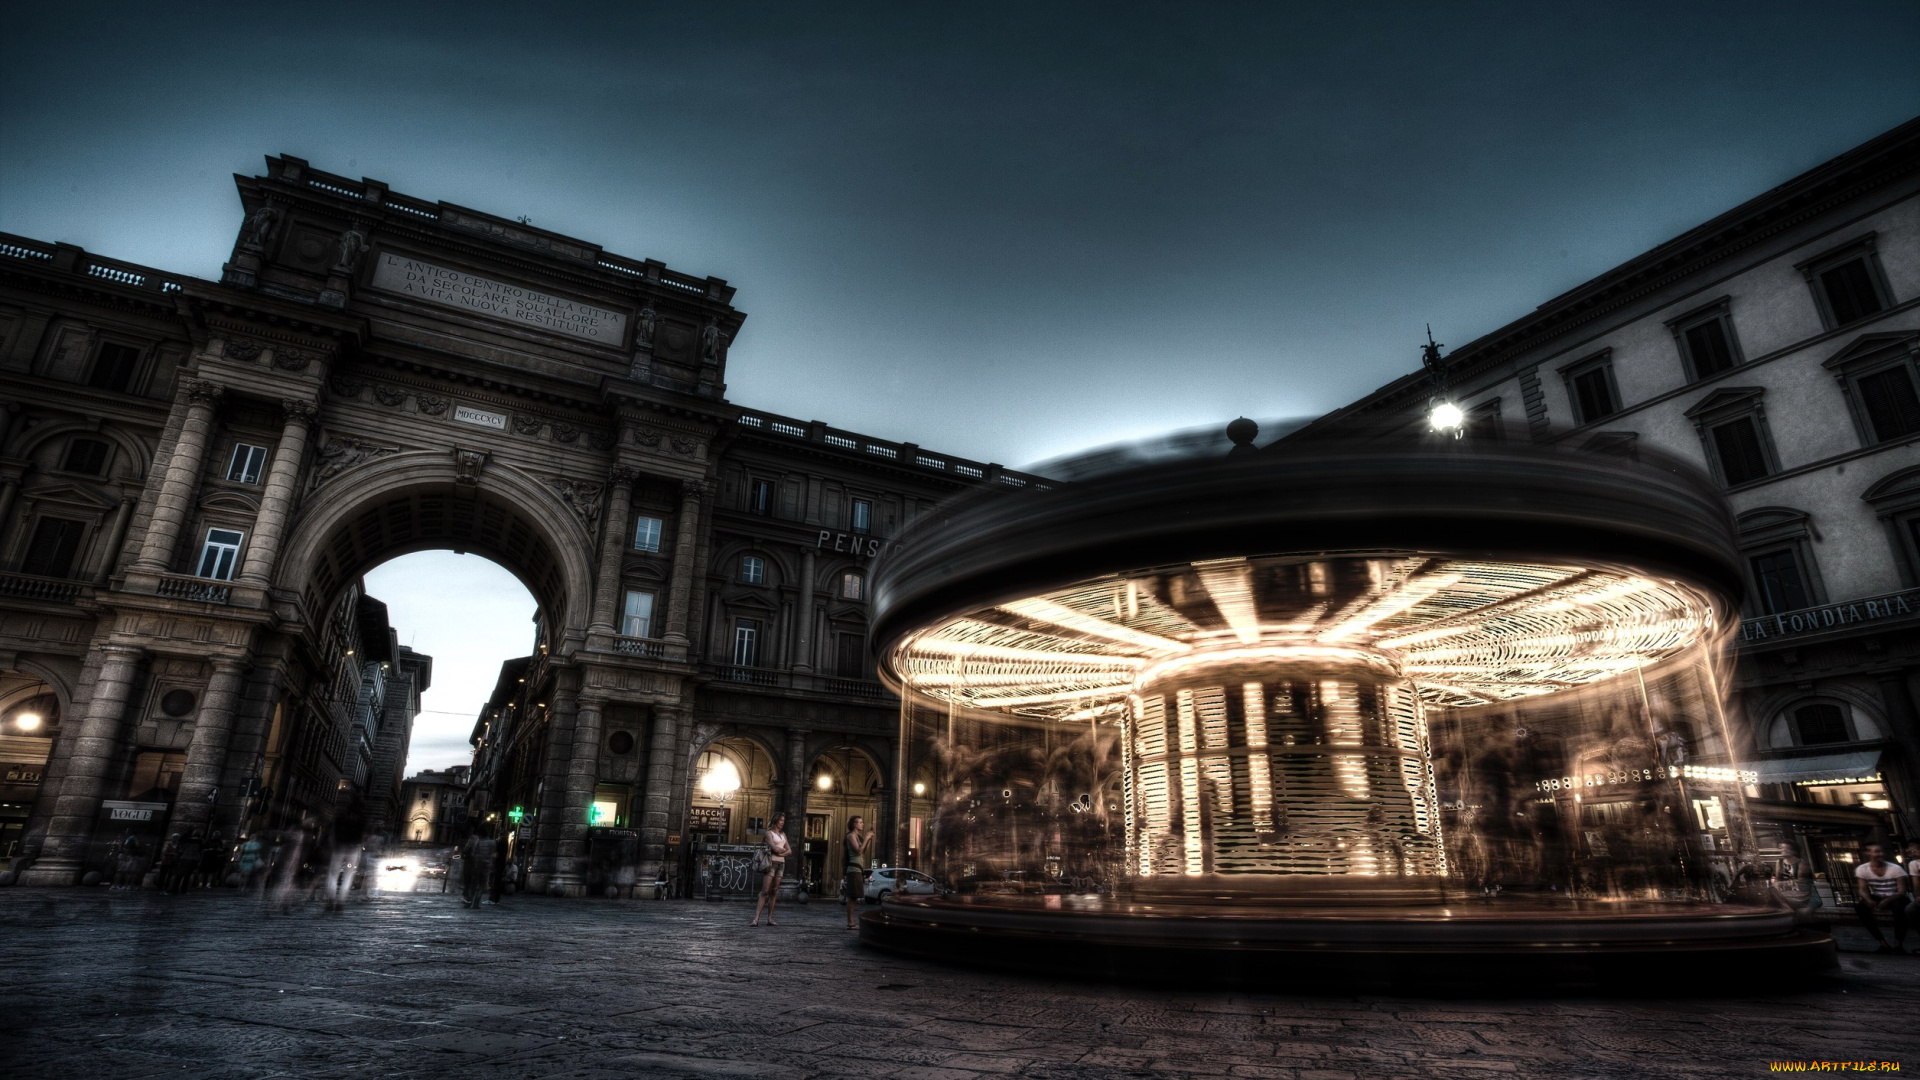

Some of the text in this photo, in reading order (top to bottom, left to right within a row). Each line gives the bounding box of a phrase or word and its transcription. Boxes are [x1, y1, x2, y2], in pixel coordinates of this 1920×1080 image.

[404, 261, 459, 281] ANTICO
[464, 276, 523, 298] CENTRO
[527, 292, 574, 312] DELLA
[404, 282, 598, 337] A VITA NUOVA RESTITUITO
[406, 271, 599, 327] DA SECOLARE SQUALLORE
[457, 409, 503, 425] MDCCCXCV
[1742, 595, 1912, 641] LA FONDIARIA
[113, 809, 152, 820] VOGUE
[690, 808, 725, 817] ABACCHI
